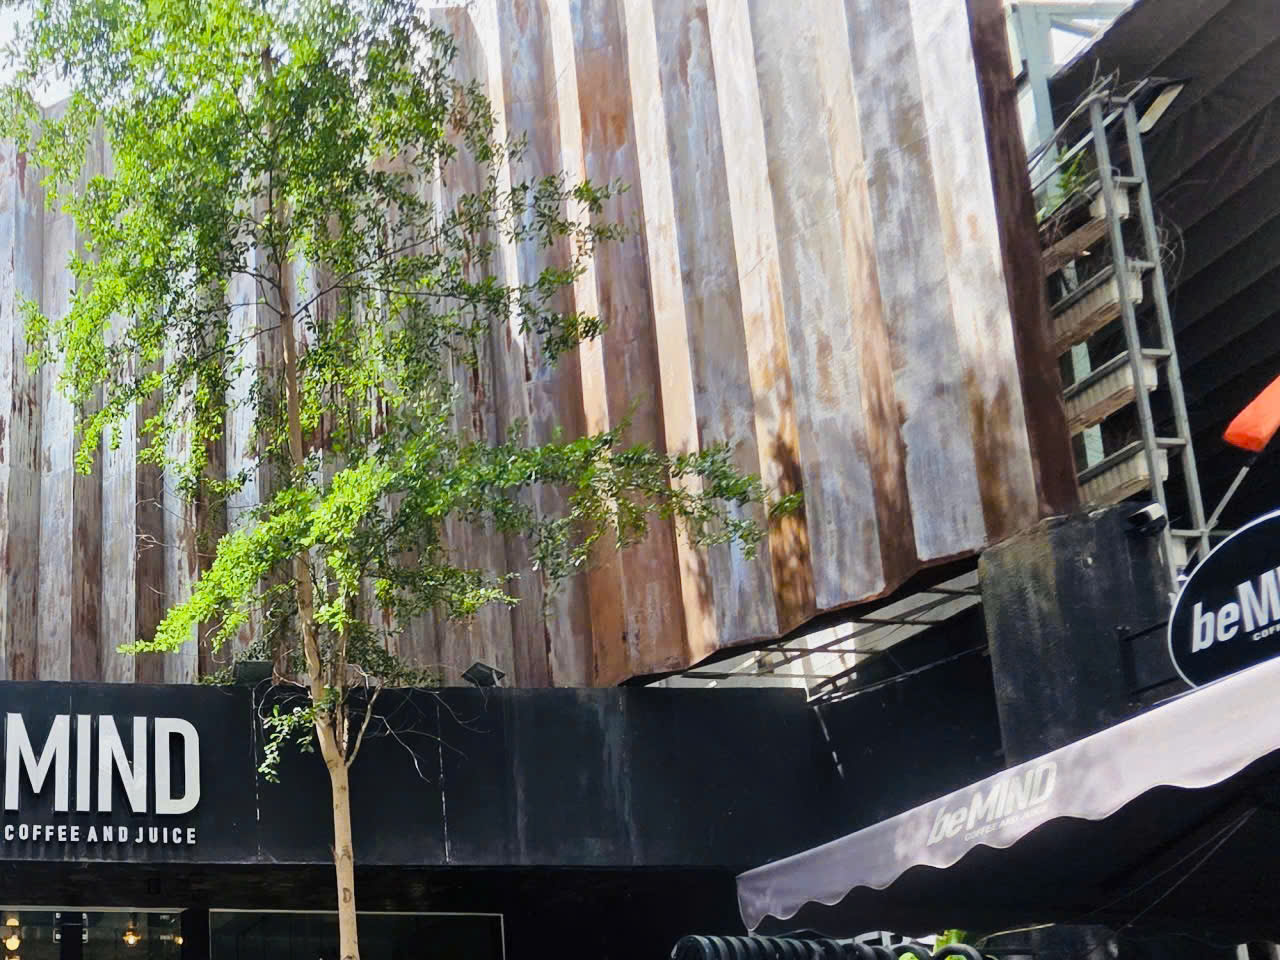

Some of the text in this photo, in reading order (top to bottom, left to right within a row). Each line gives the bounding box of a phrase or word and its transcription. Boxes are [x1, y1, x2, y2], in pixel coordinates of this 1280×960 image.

[926, 761, 1057, 847] beMIND
[4, 824, 197, 845] COFFEE AND JUICE
